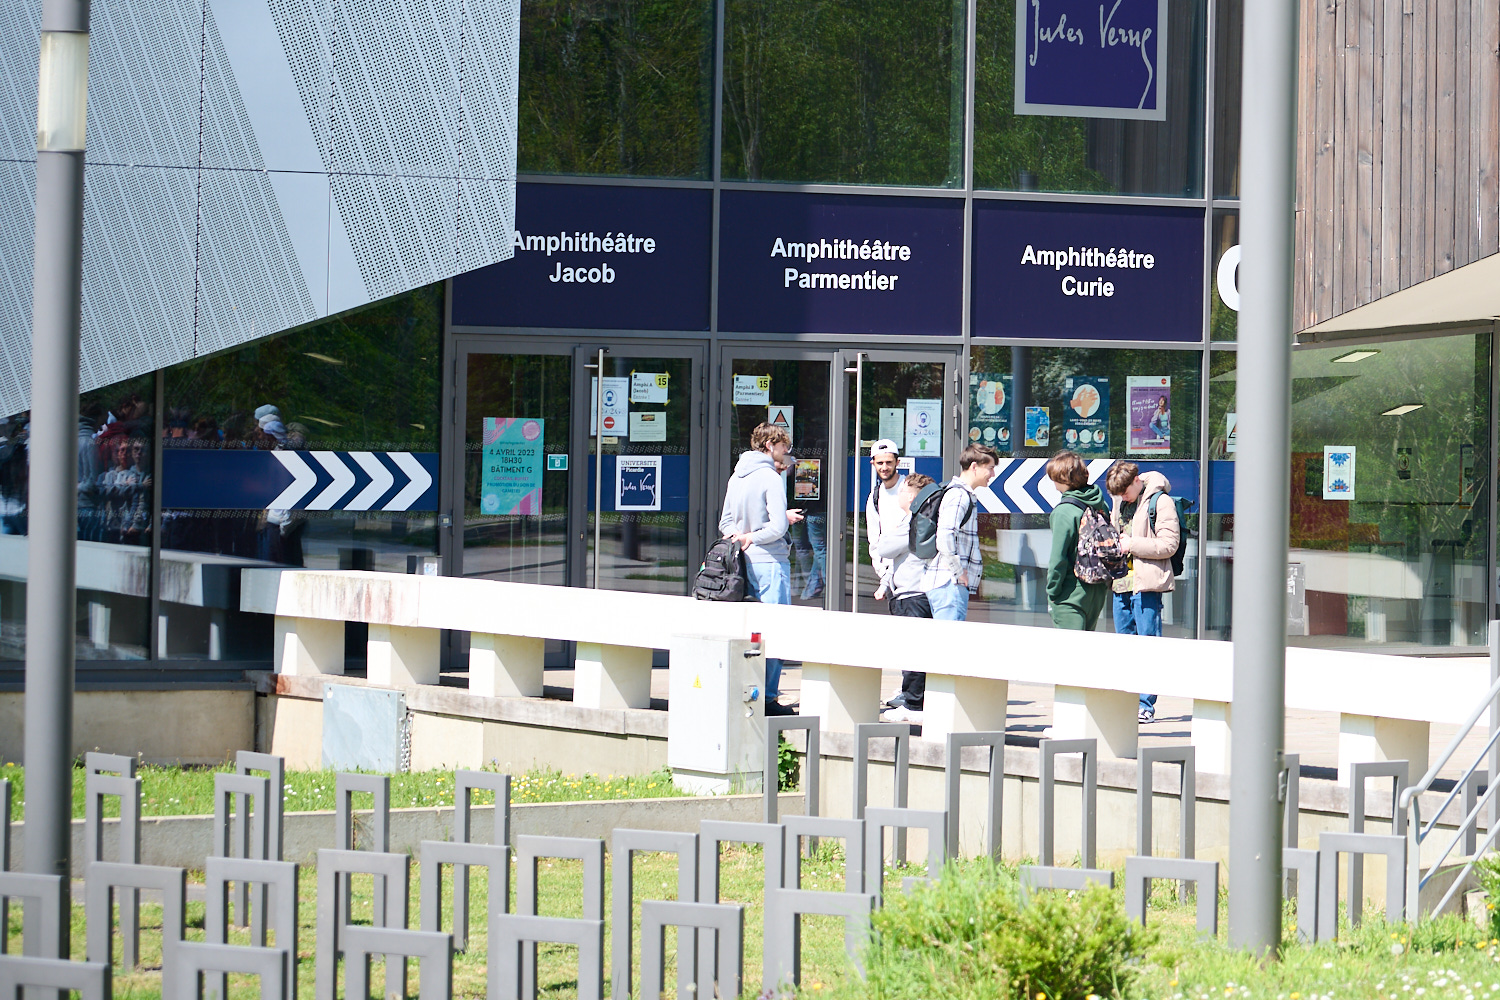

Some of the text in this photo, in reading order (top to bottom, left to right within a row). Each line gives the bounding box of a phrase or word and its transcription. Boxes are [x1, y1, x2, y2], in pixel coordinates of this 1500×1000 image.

[512, 230, 656, 255] Amphithéâtre
[770, 237, 911, 263] Amphithéâtre
[1021, 244, 1155, 270] Amphithéâtre
[549, 262, 616, 283] Jacob
[783, 267, 898, 290] Parmentier
[1061, 275, 1115, 297] Curie
[658, 377, 667, 386] 15
[760, 380, 768, 389] 15
[491, 465, 525, 473] BÂTIMENT
